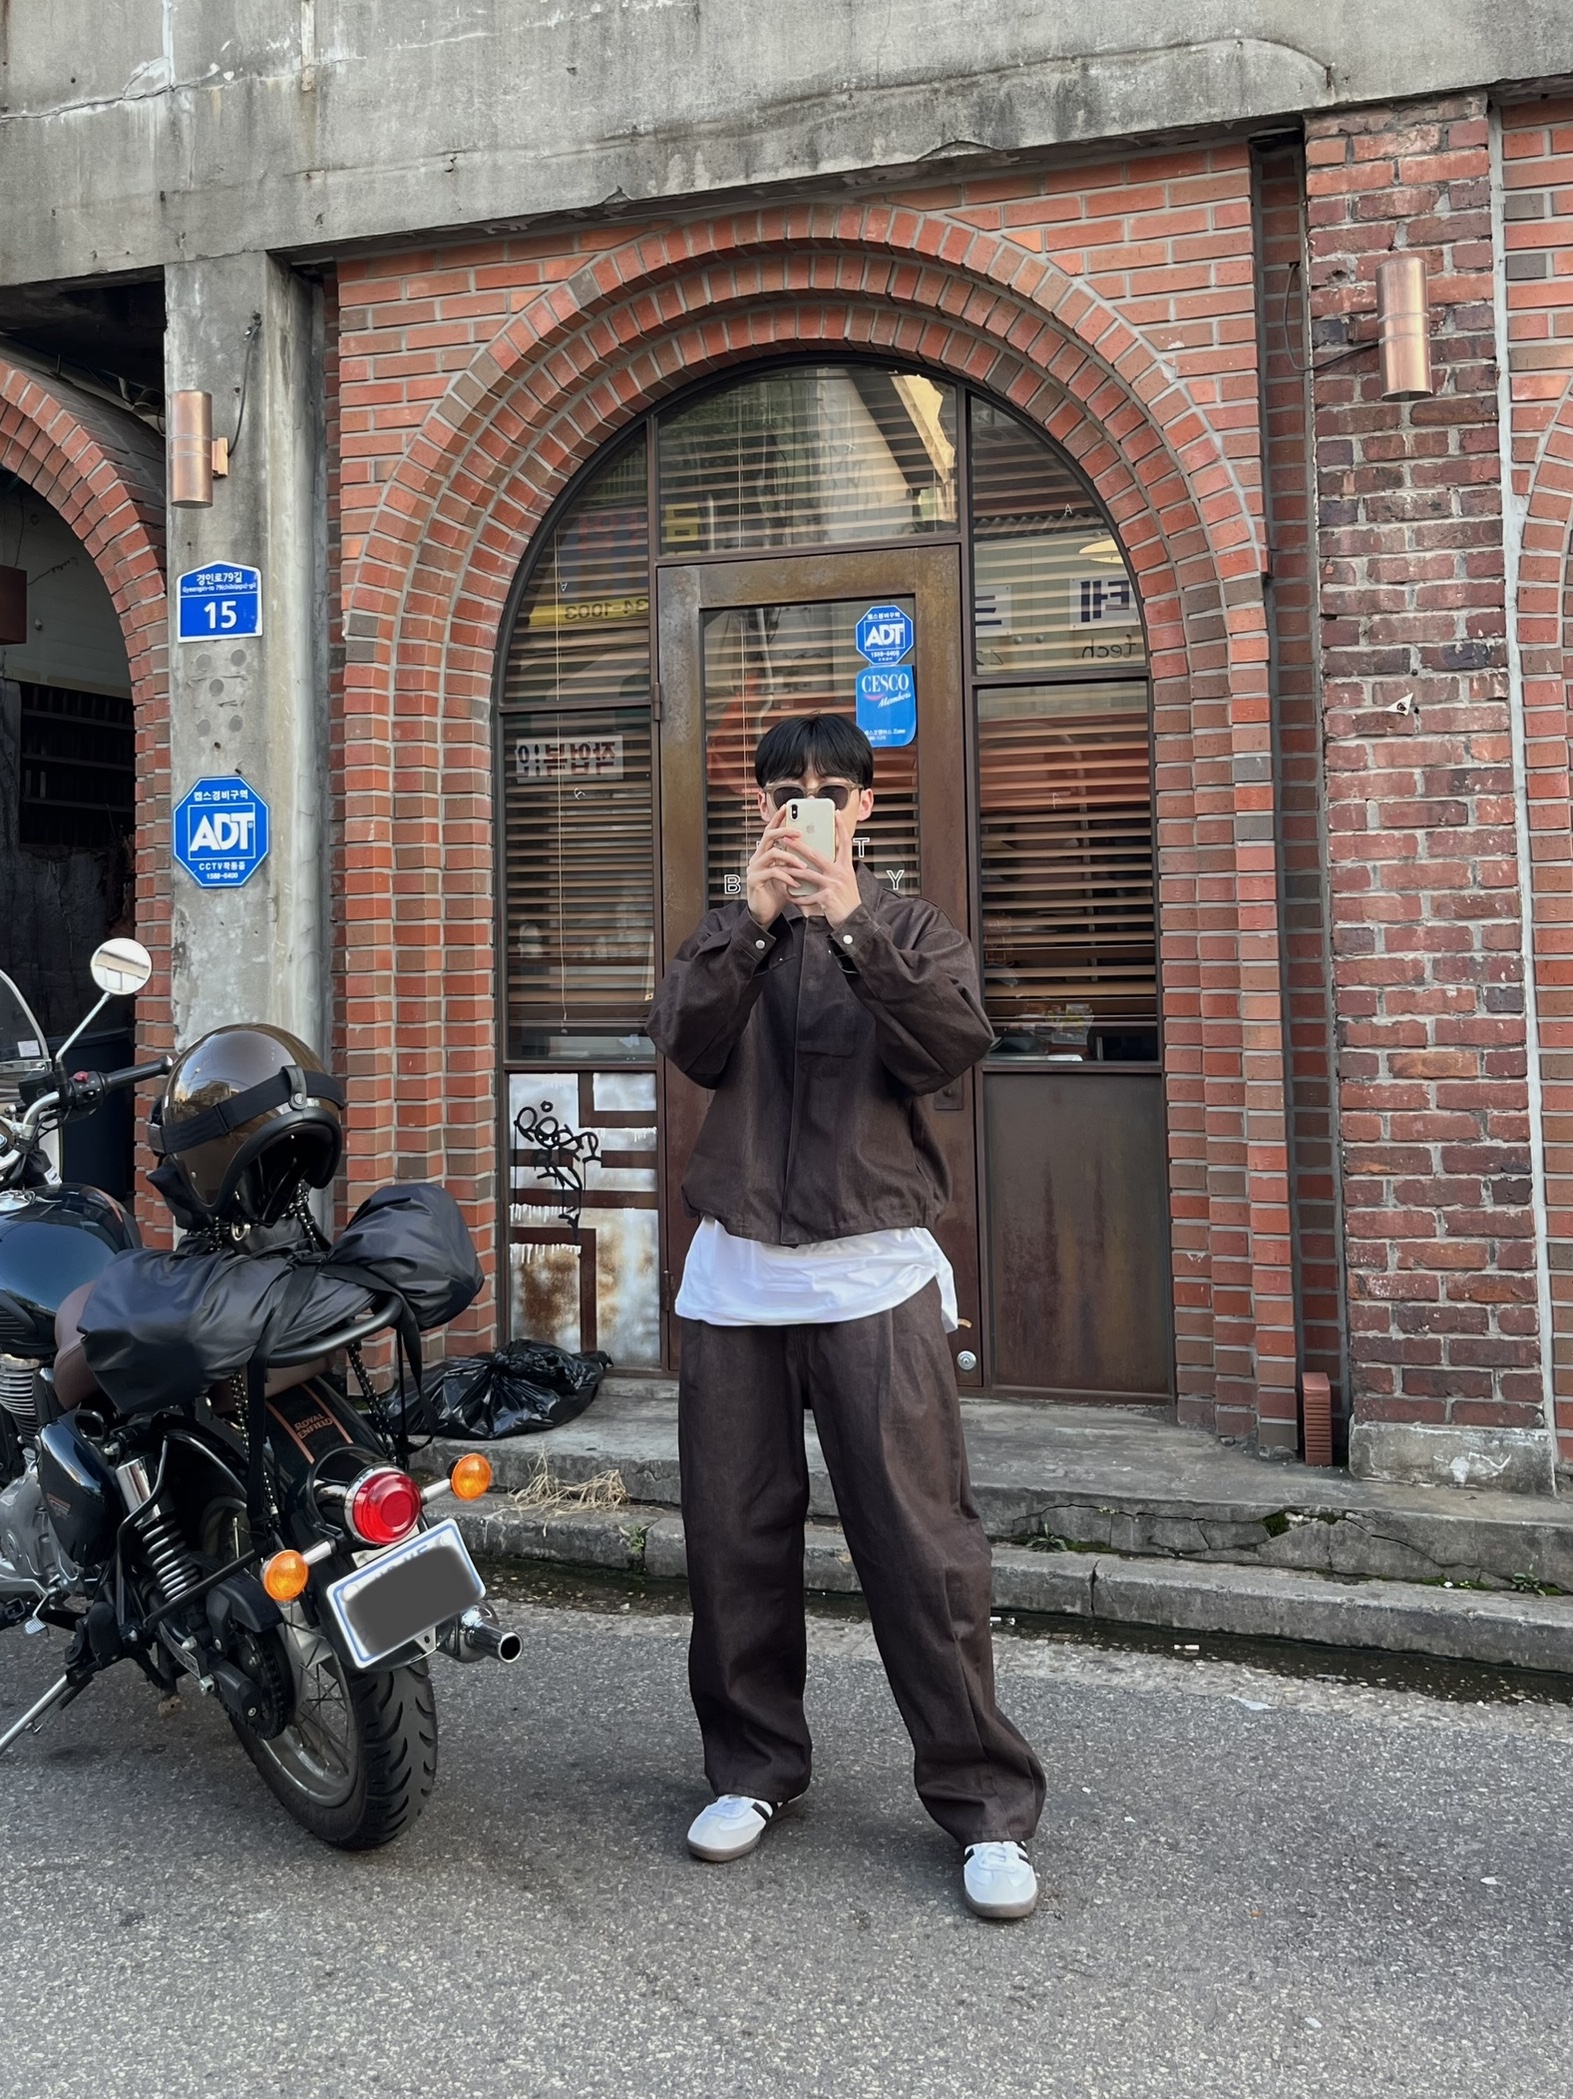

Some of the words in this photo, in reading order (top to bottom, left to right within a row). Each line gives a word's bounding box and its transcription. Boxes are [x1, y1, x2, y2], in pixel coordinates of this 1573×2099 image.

[196, 572, 243, 586] 경인로79길
[203, 600, 237, 629] 15
[865, 624, 904, 647] ADT
[861, 673, 909, 694] CESCO
[189, 812, 255, 851] ADT
[294, 1413, 325, 1431] ROYAL
[297, 1417, 334, 1439] ENFIELD
